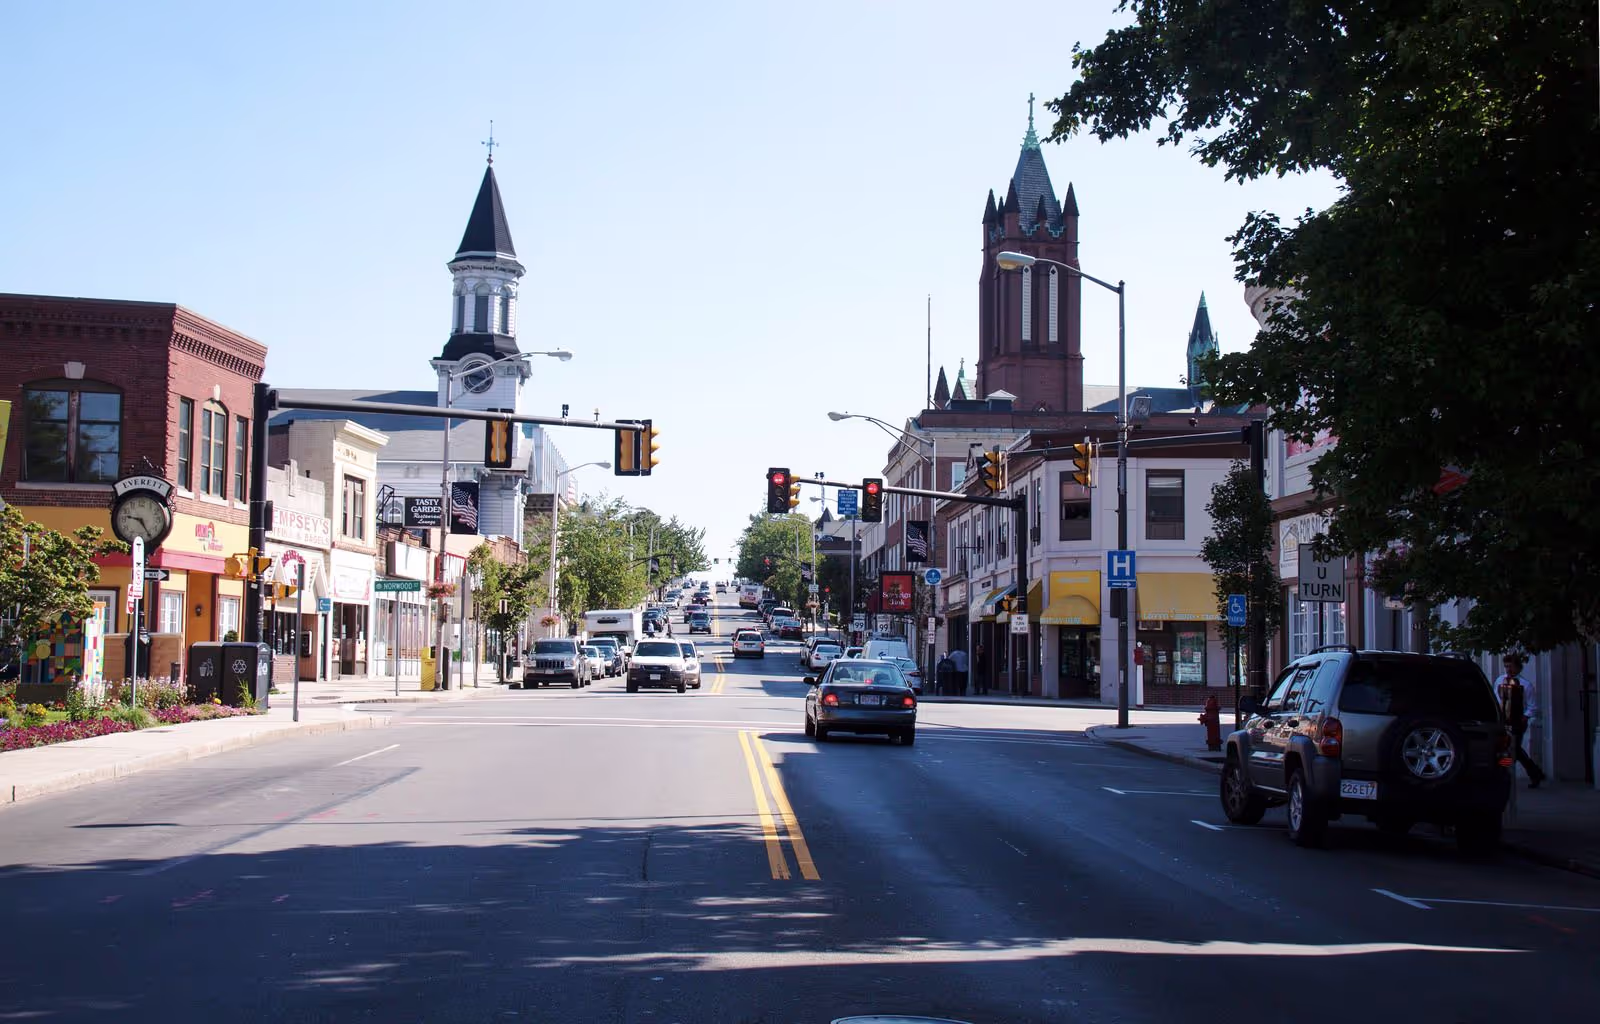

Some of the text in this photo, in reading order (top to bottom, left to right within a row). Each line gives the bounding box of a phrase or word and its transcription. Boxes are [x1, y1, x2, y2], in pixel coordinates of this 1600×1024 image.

[122, 479, 164, 489] EVERETT
[415, 498, 440, 506] TASTY
[271, 507, 330, 535] EMPSEY'S
[417, 518, 436, 526] Lounge
[1113, 555, 1131, 576] H
[1317, 566, 1327, 580] U
[383, 582, 413, 590] NORWOOD
[1303, 583, 1341, 597] TURN
[879, 624, 889, 632] 99
[1342, 783, 1358, 794] 226
